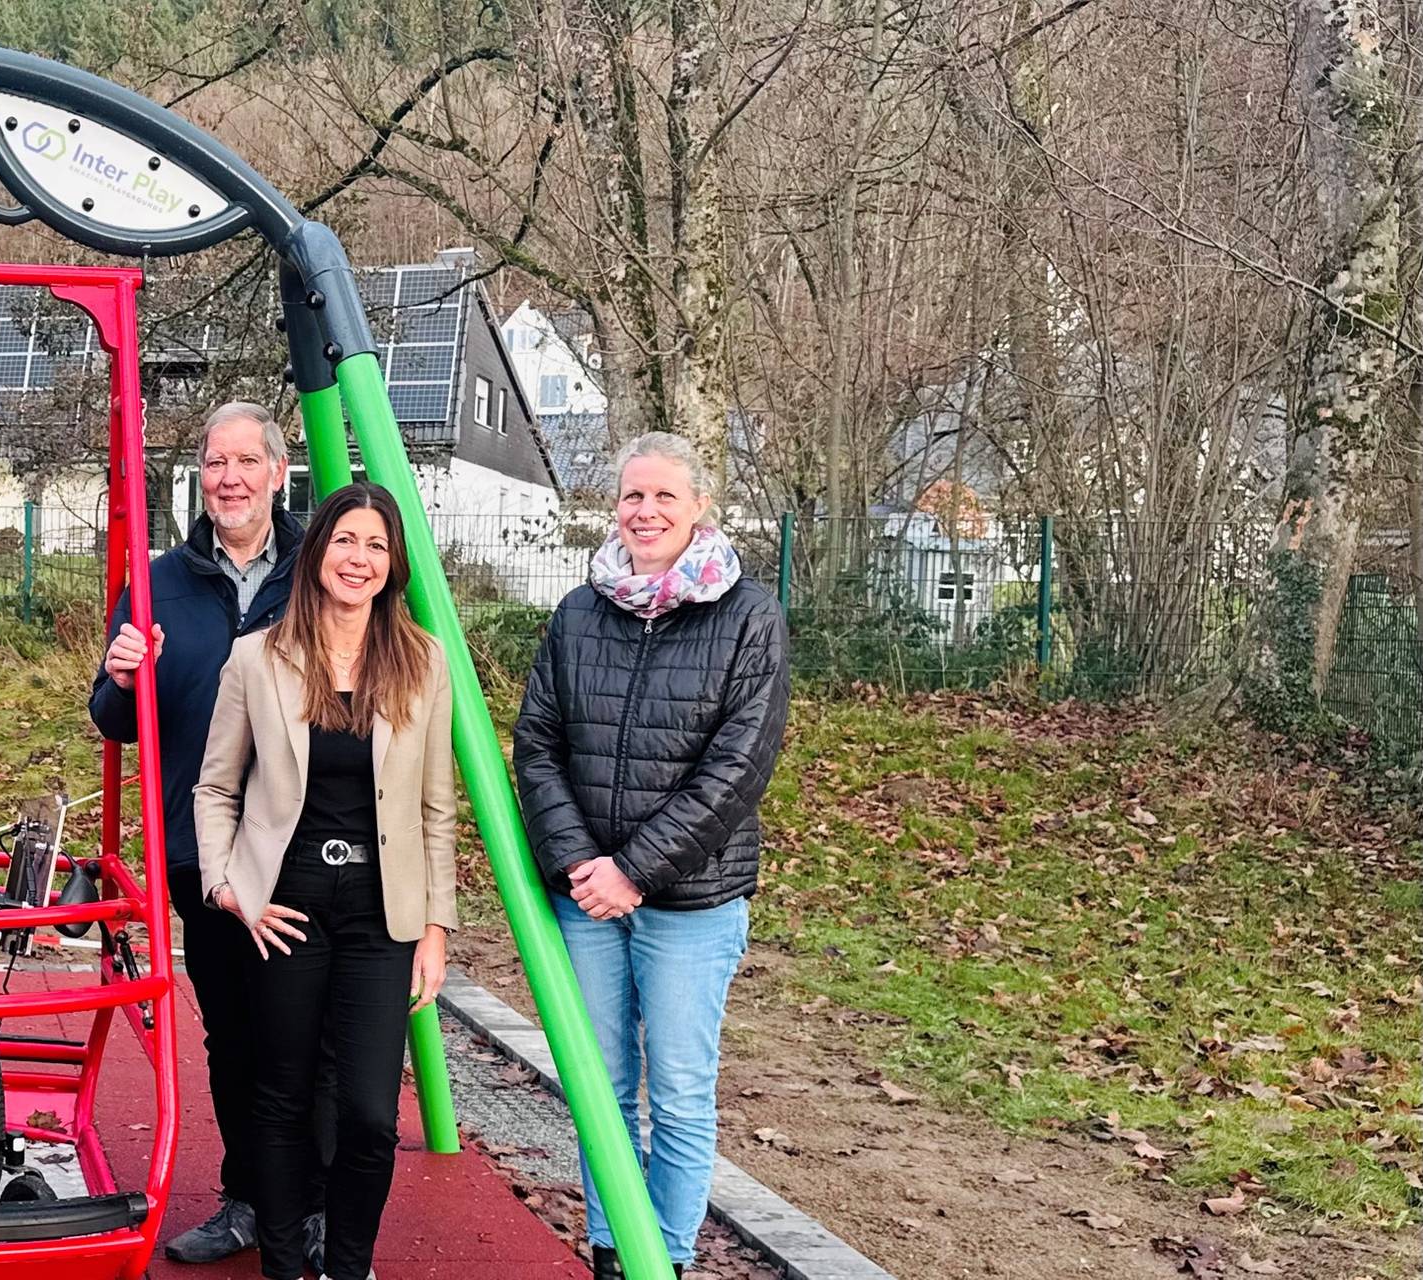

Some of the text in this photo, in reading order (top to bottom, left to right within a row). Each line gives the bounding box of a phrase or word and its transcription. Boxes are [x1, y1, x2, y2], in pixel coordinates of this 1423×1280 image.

[72, 143, 184, 213] Inter Play
[106, 183, 164, 214] PLAYGROUNDS
